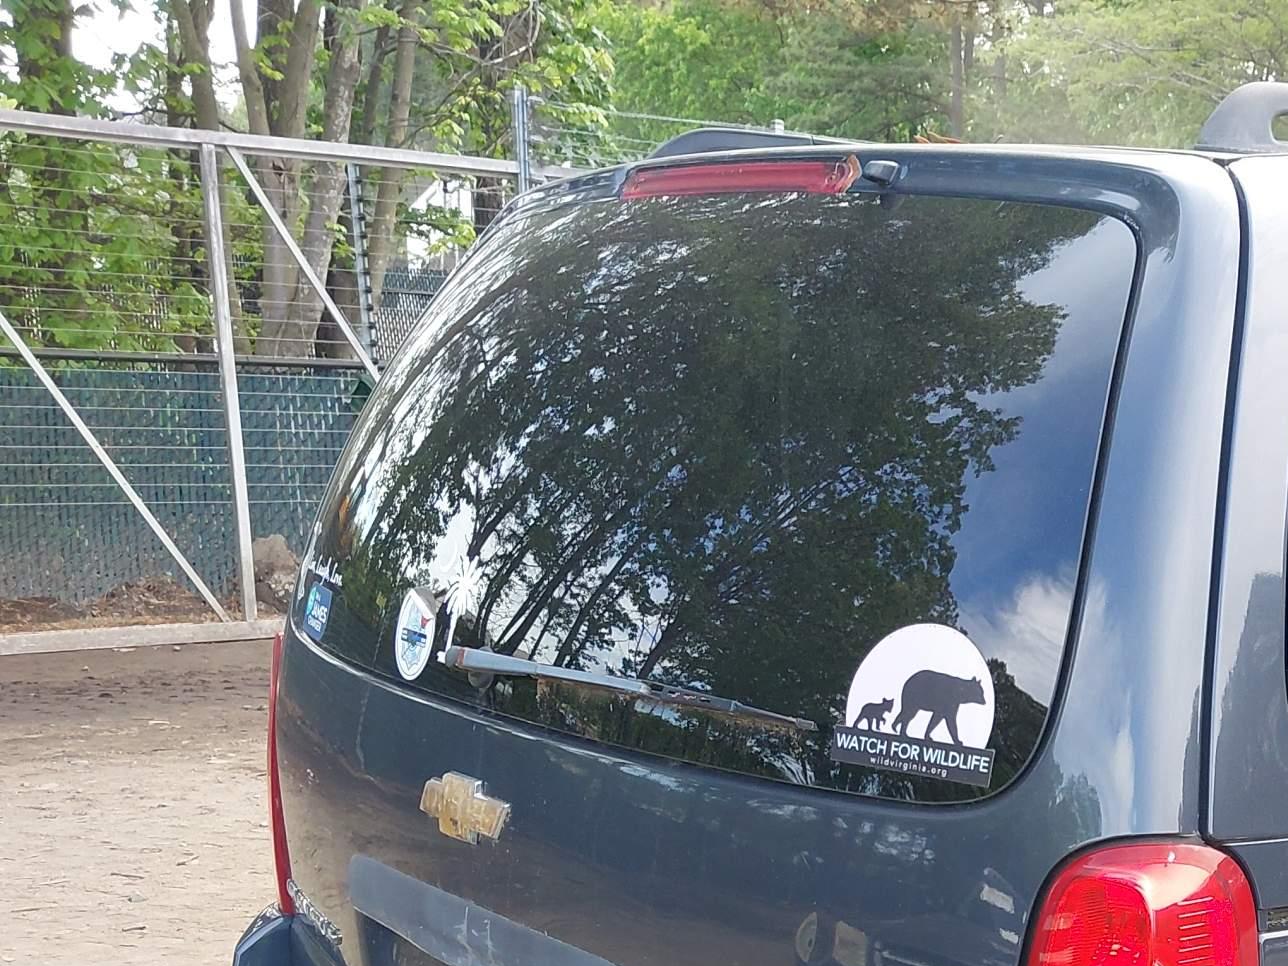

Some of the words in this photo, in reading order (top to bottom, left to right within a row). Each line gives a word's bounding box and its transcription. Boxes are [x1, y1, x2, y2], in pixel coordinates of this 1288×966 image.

[836, 733, 887, 756] WATCH
[889, 741, 920, 761] FOR
[922, 747, 990, 773] WILDLIFE
[869, 756, 949, 777] wildvirginia.org
